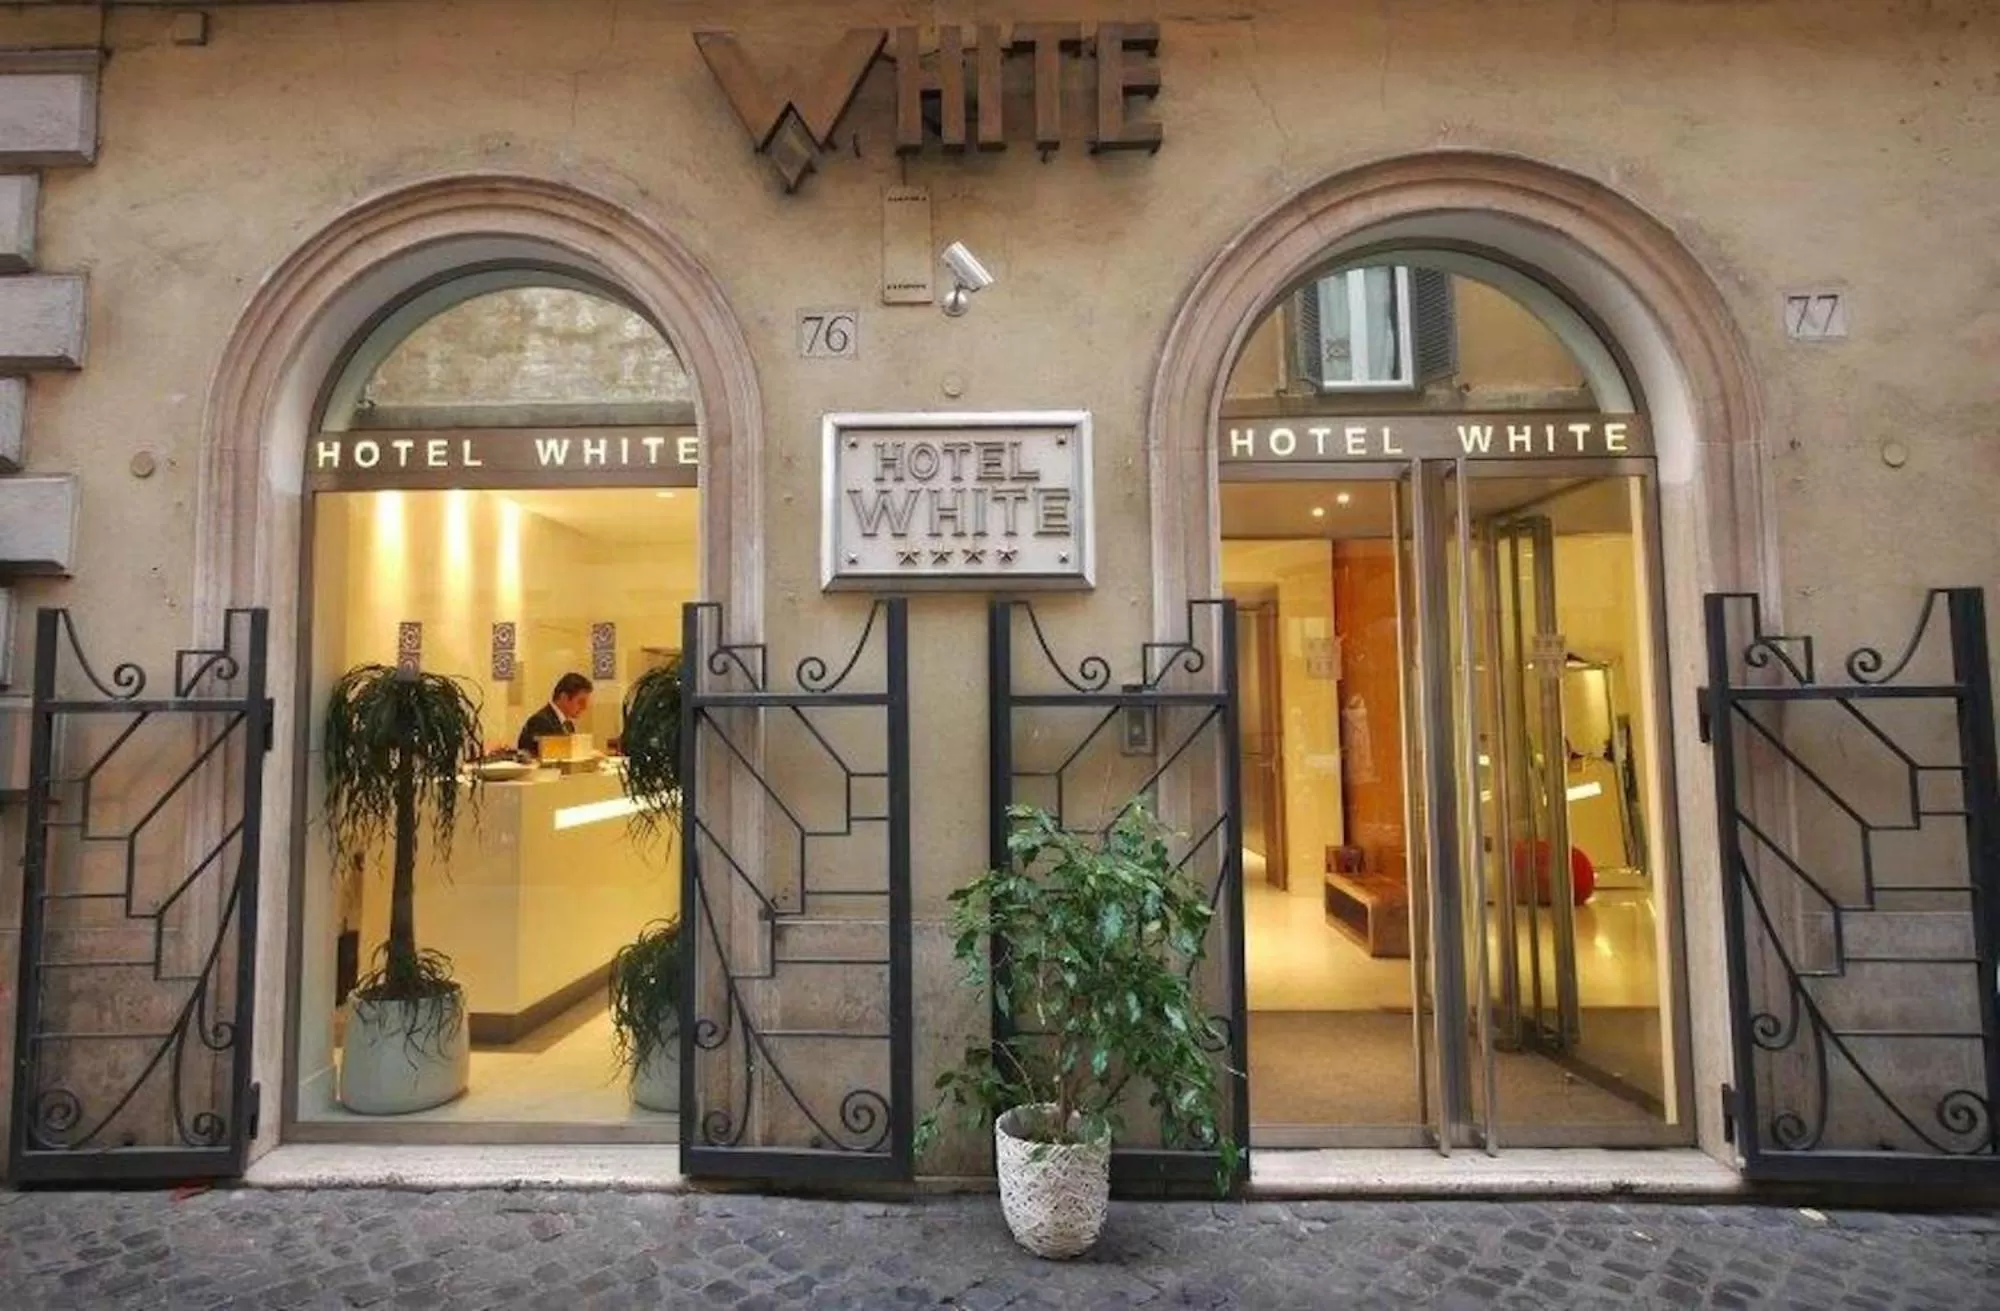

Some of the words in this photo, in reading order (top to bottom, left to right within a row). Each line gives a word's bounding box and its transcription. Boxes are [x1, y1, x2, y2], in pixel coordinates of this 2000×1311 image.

[694, 22, 1163, 192] WHITE
[801, 314, 854, 354] 76
[1787, 293, 1838, 334] 77
[315, 438, 482, 468] HOTEL
[535, 435, 699, 466] WHITE
[1229, 426, 1404, 457] HOTEL
[1457, 422, 1629, 453] WHITE
[873, 441, 1041, 483] HOTEL
[846, 486, 1072, 538] WHITE
